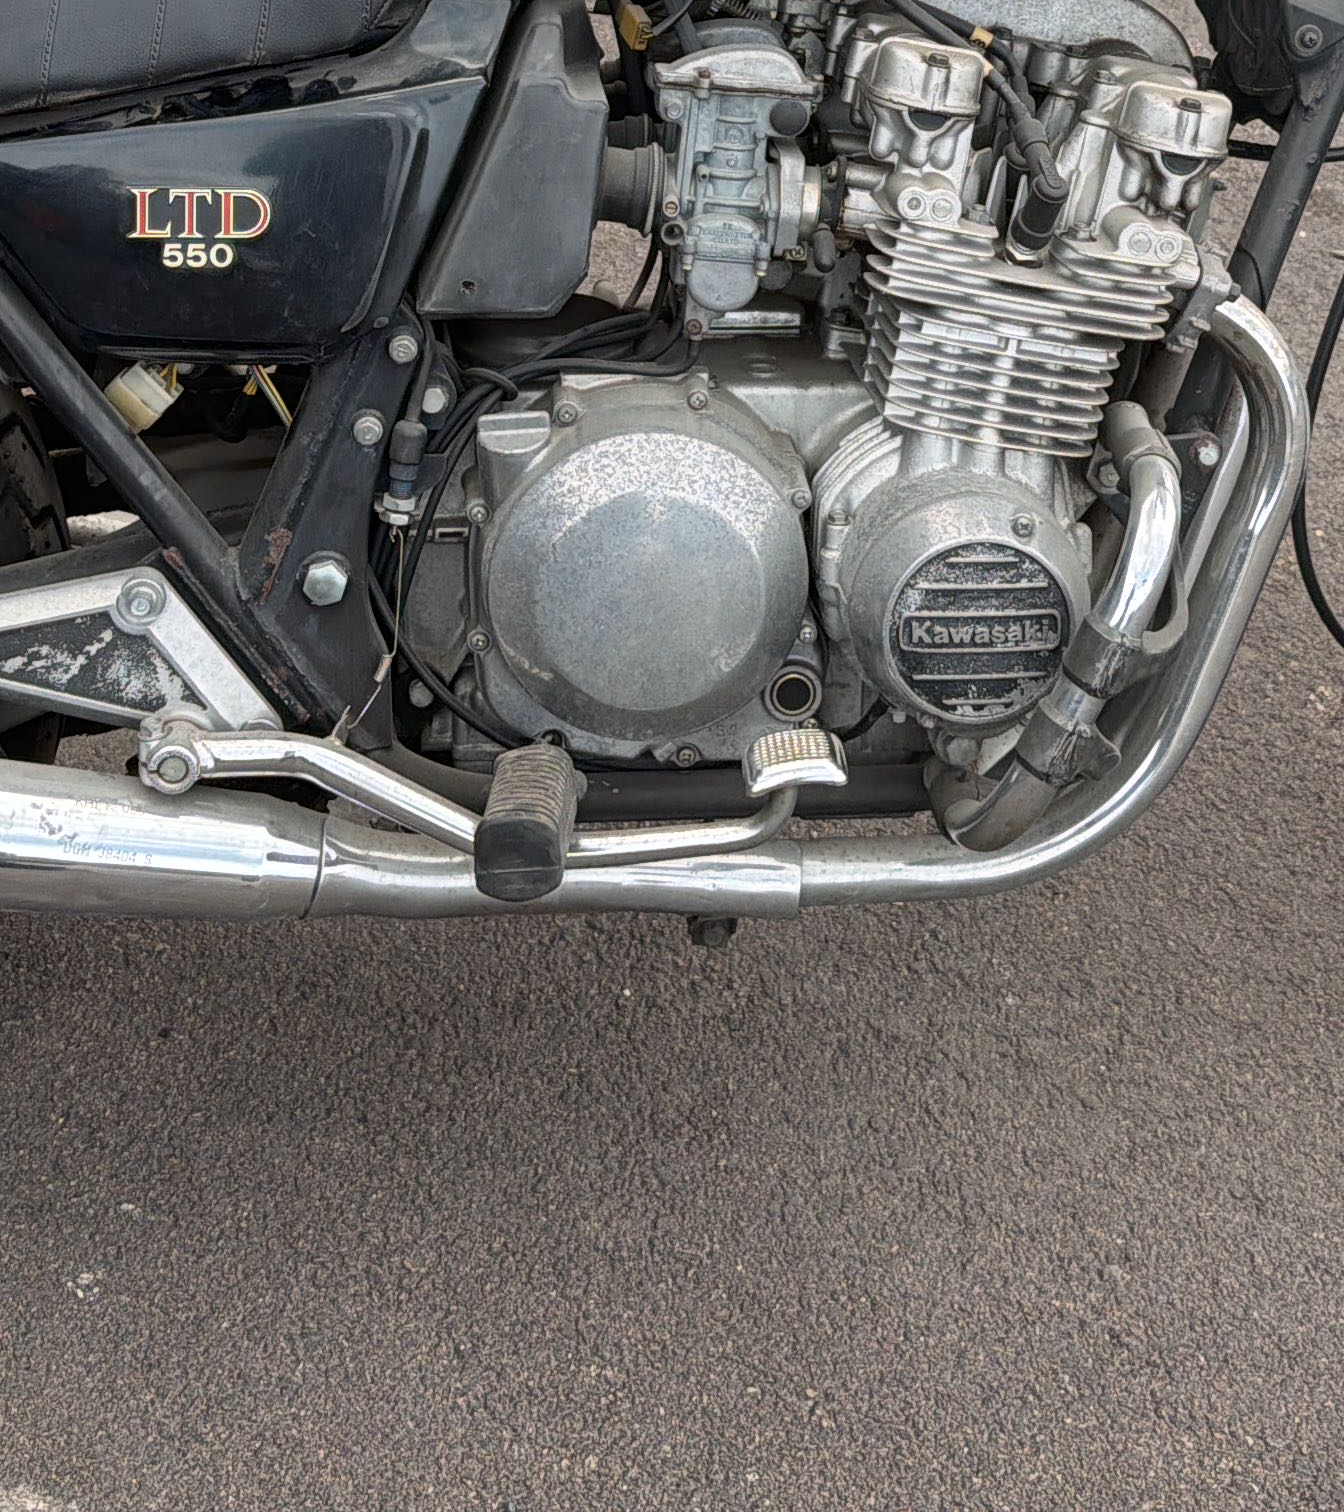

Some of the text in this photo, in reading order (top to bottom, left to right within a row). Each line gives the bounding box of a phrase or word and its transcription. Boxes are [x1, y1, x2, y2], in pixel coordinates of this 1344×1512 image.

[125, 186, 273, 239] LTD
[162, 243, 234, 269] 550
[910, 619, 1050, 645] Kawasaki
[144, 854, 153, 865] S
